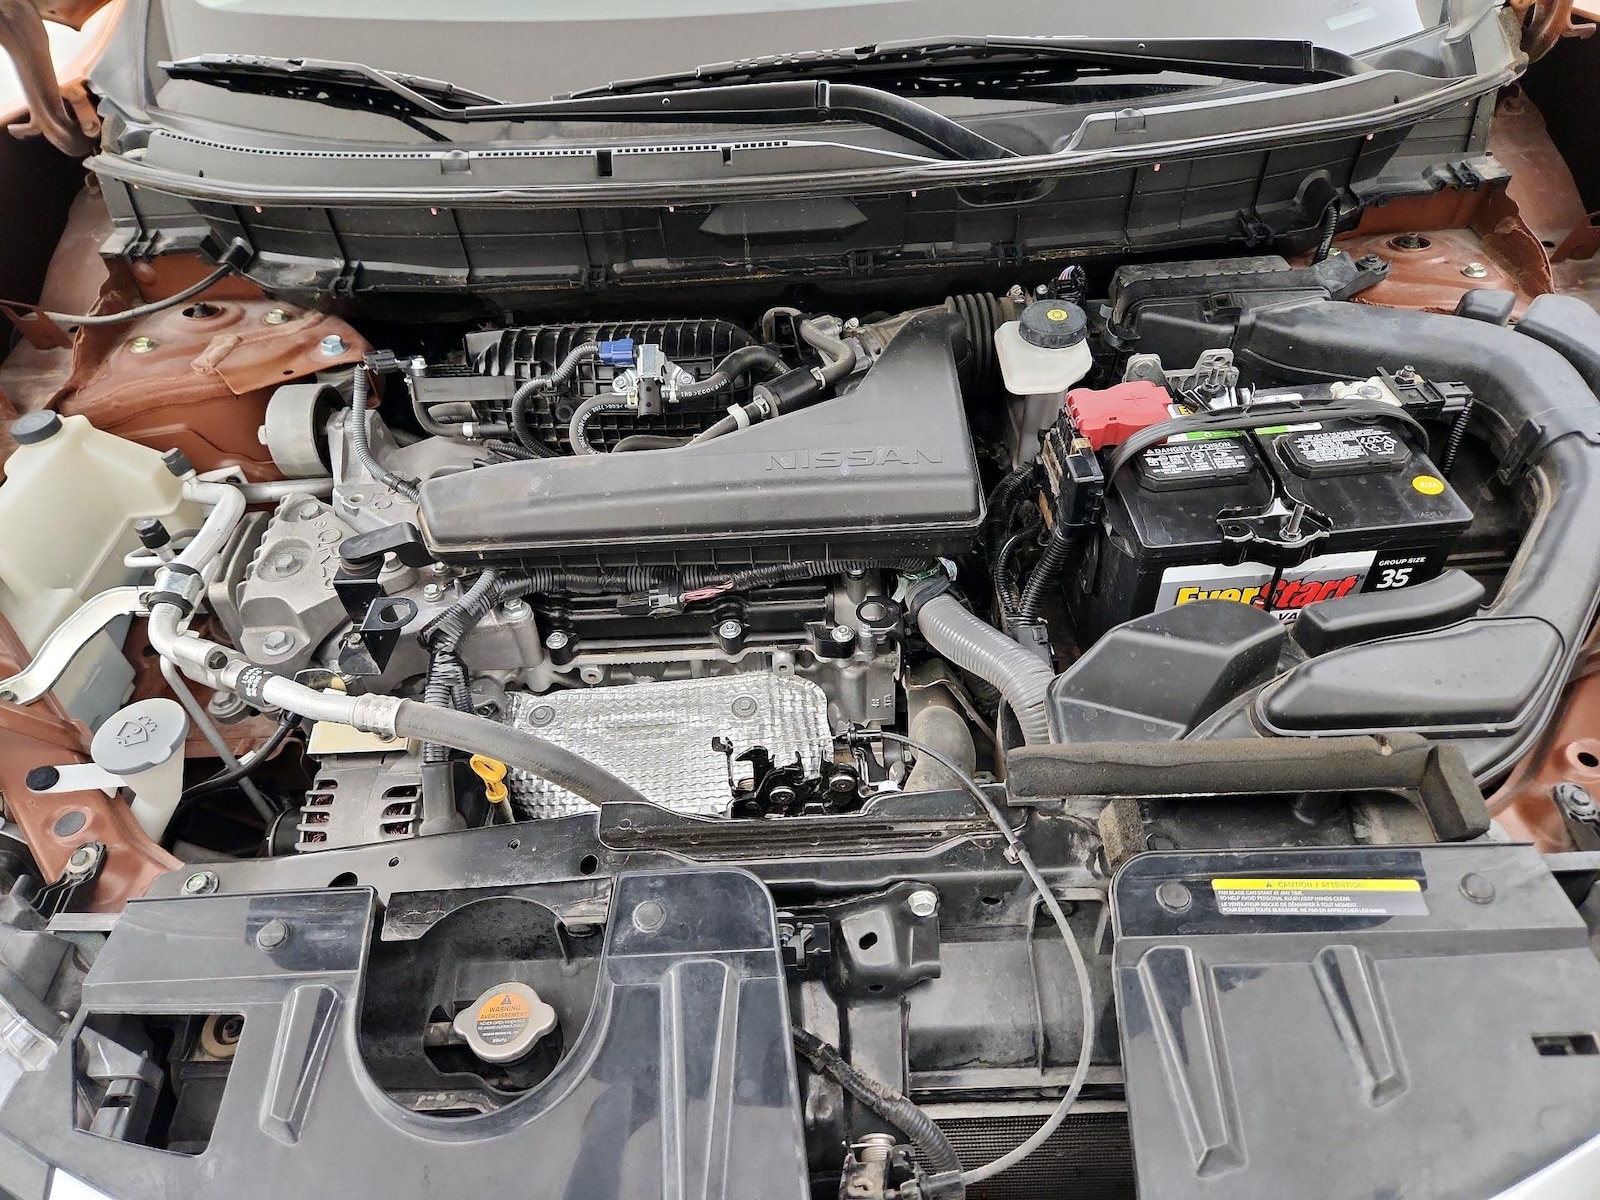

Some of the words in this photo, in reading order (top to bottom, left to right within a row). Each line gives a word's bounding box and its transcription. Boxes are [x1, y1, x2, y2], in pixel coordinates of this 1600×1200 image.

[1154, 445, 1190, 454] DANGER
[1199, 441, 1231, 450] POISON
[765, 448, 943, 470] NISSAN
[1378, 558, 1407, 567] GROUP
[1407, 556, 1427, 564] SIZE
[1376, 567, 1413, 589] 35
[489, 1004, 521, 1012] WARNING
